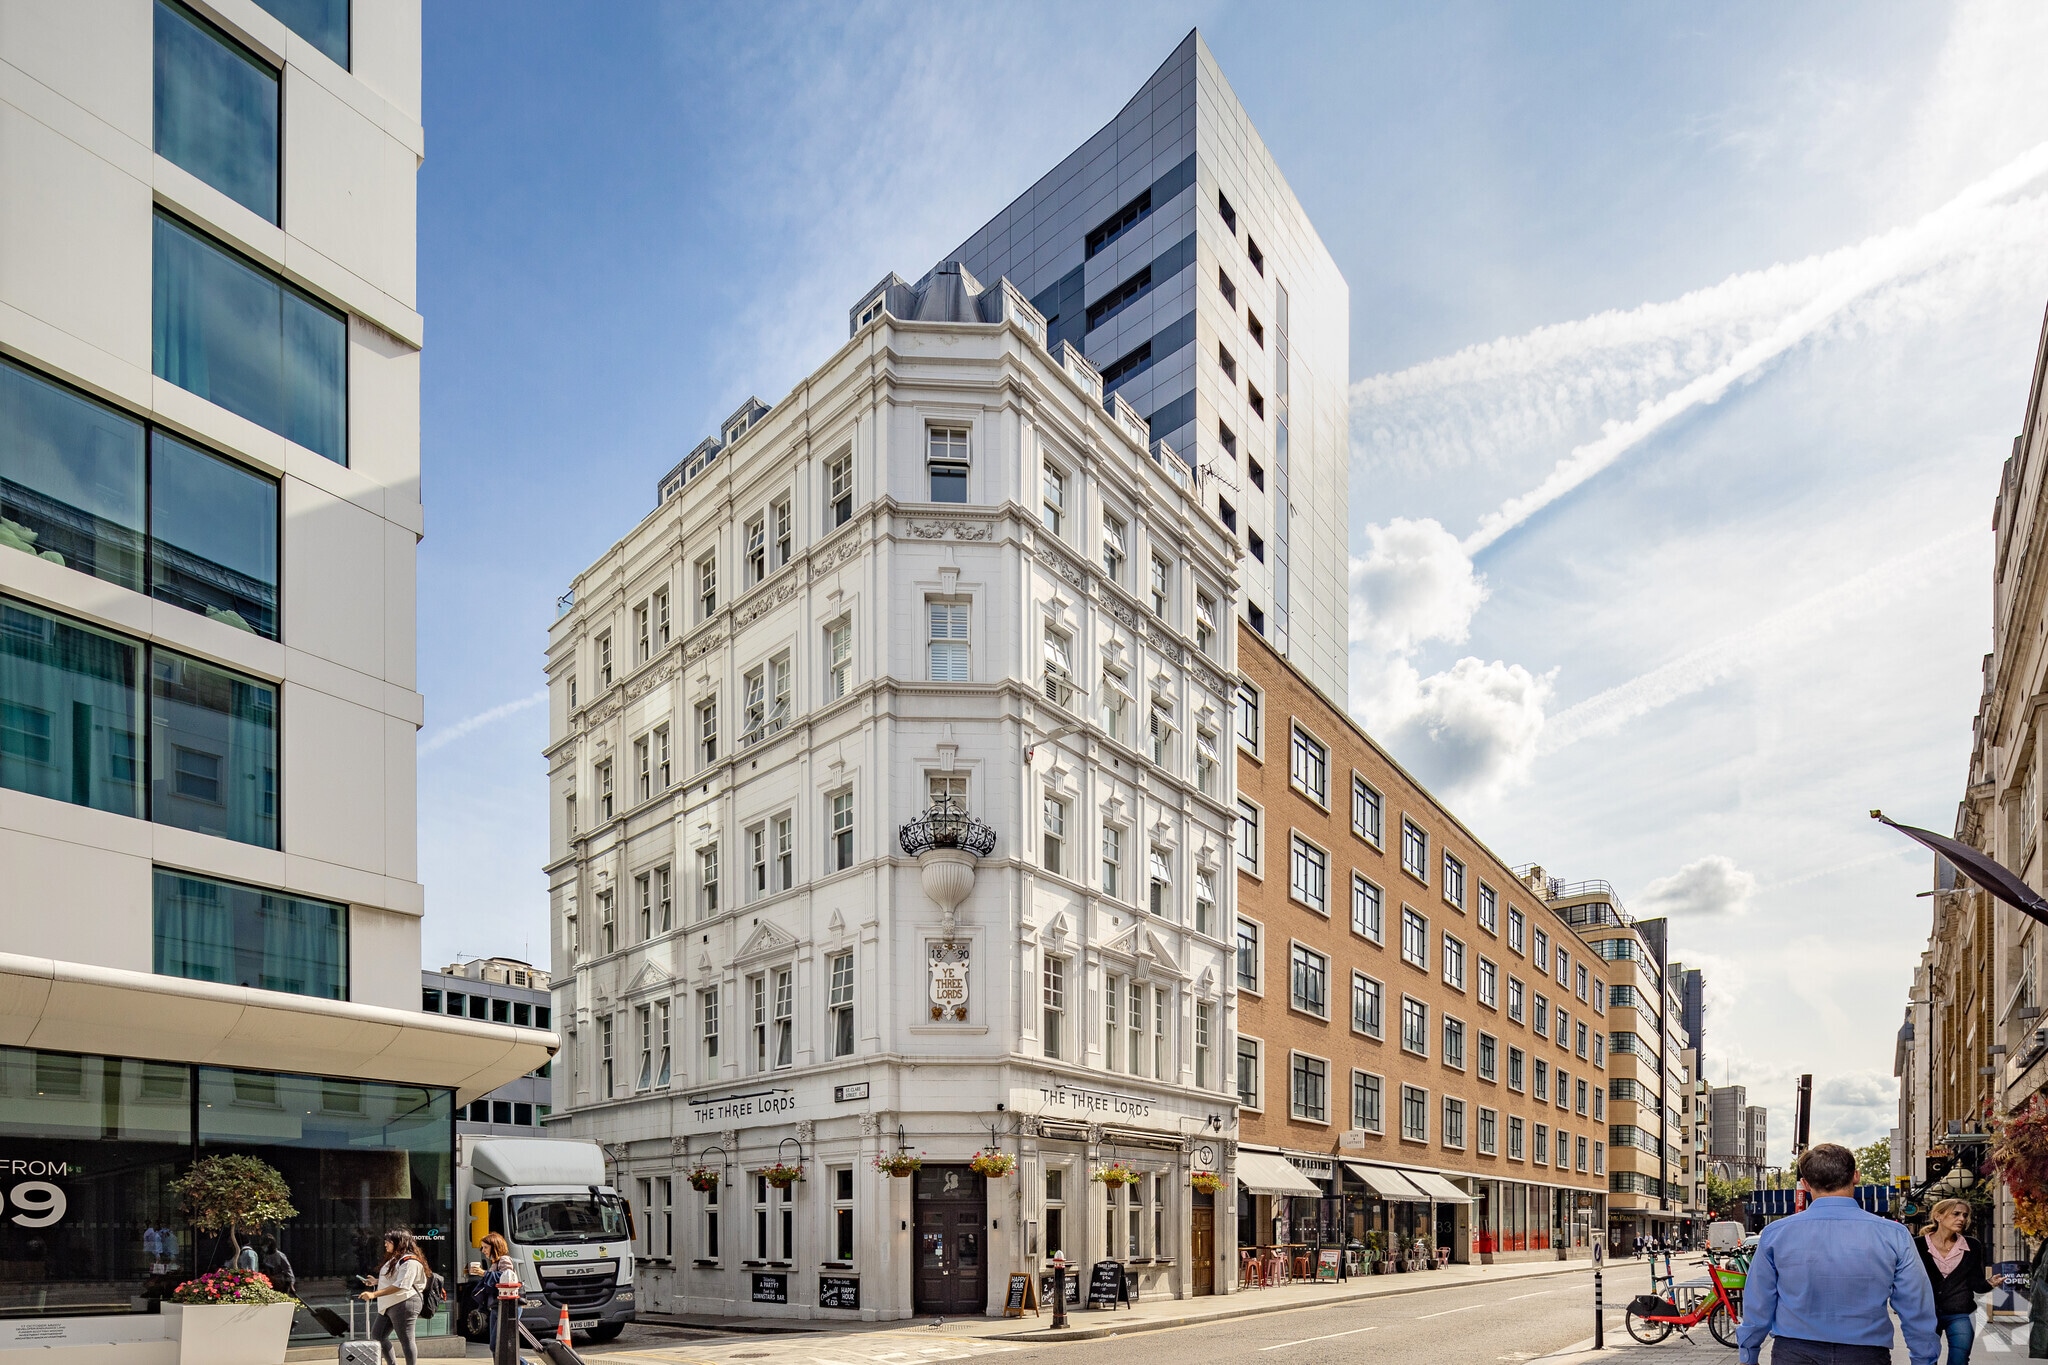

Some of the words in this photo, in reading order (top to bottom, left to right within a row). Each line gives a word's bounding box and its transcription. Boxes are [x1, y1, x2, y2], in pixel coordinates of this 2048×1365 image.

[931, 949, 942, 958] 18
[958, 950, 970, 959] 90
[942, 968, 955, 978] YE
[936, 979, 963, 988] THREE
[936, 990, 963, 999] LORDS
[1040, 1088, 1065, 1106] THE
[1072, 1092, 1108, 1112] THREE
[1114, 1098, 1149, 1118] LORDS
[694, 1108, 714, 1124] THE
[718, 1103, 752, 1118] THREE
[758, 1097, 794, 1114] LORDS
[0, 1160, 68, 1176] FROM
[1302, 1159, 1306, 1168] &
[1307, 1160, 1330, 1170] LETTUCE
[0, 1181, 67, 1228] 9
[546, 1248, 579, 1258] brakes
